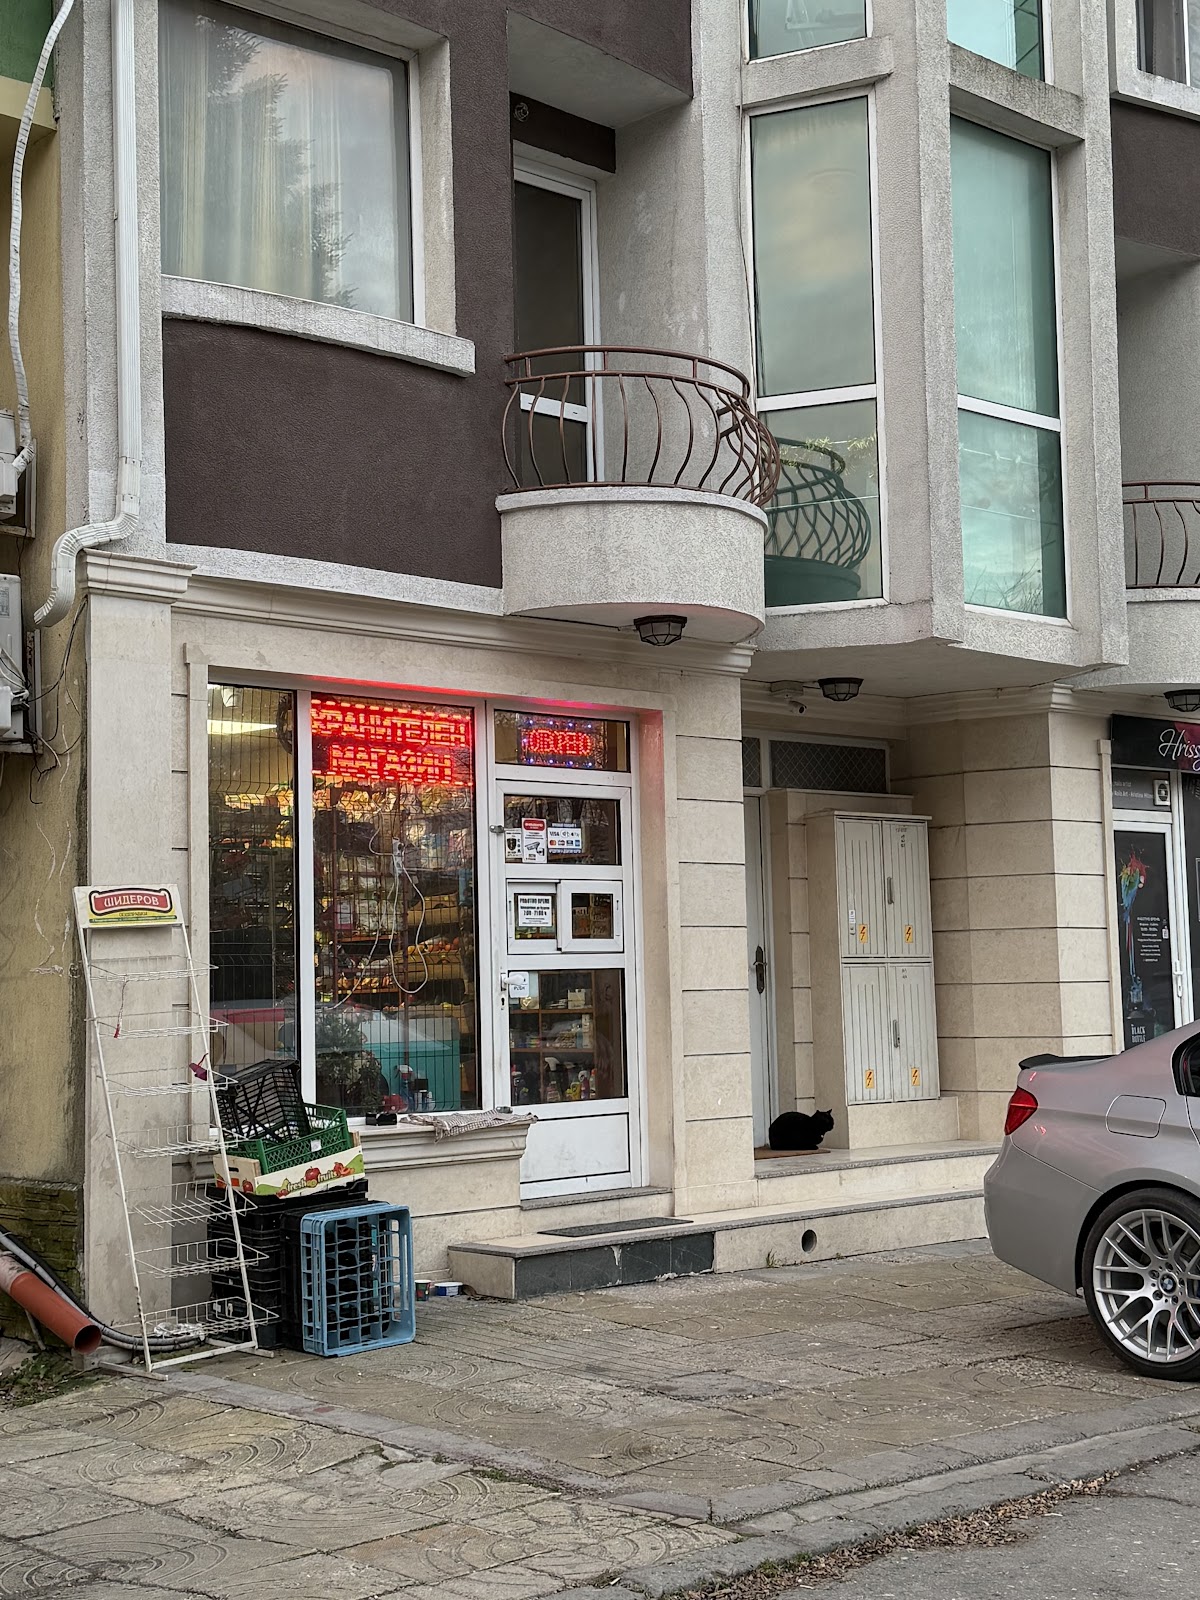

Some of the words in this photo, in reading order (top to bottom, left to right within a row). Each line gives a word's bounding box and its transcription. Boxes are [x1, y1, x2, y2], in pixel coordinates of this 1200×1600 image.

[311, 708, 466, 747] ХРАНИТЕЛЕН
[529, 728, 591, 756] OPEN
[1158, 728, 1200, 771] Hriss
[331, 744, 452, 781] МАГАЗИН
[104, 894, 160, 907] ШИДЕРОВ
[1132, 1026, 1146, 1034] BLACK
[288, 1178, 306, 1192] fresh
[317, 1170, 338, 1182] fruits
